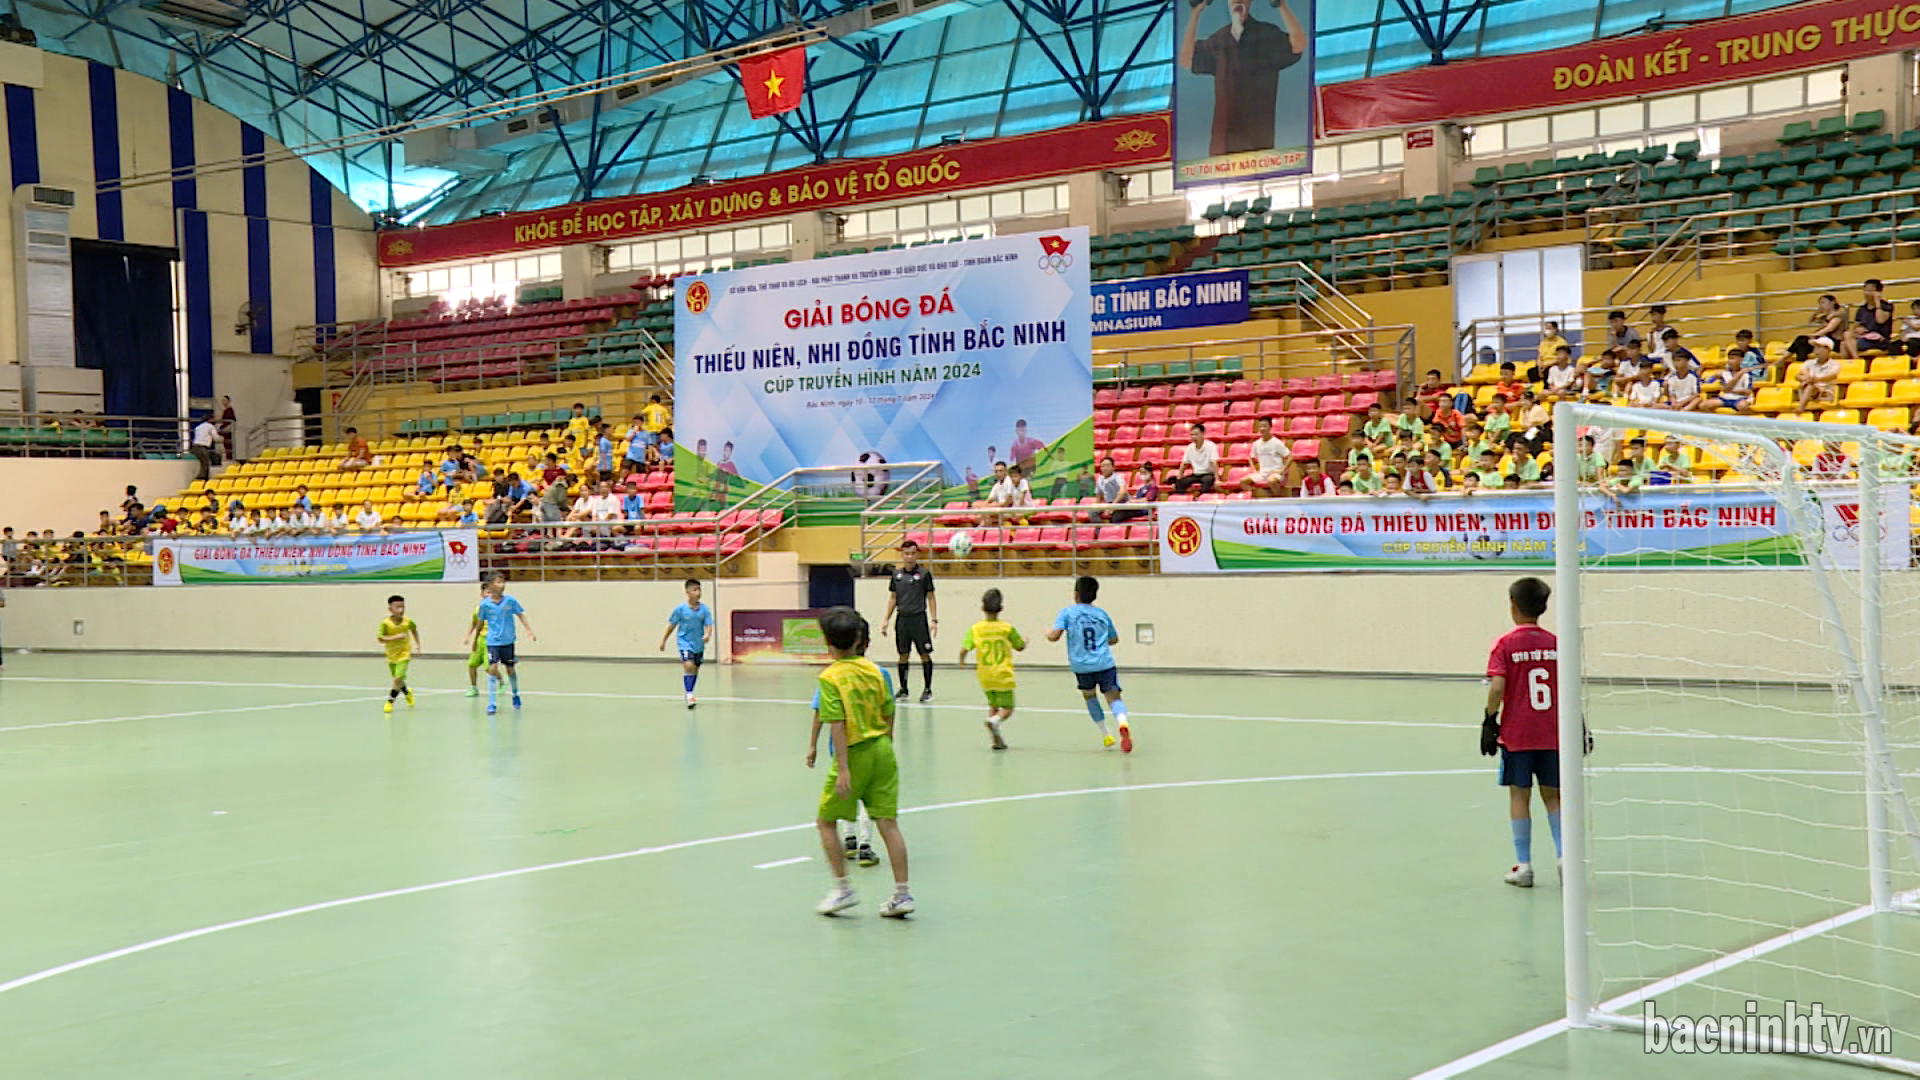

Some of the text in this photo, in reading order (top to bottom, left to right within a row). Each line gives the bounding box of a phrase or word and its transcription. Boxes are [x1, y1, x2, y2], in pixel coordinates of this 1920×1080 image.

[1553, 53, 1636, 91] ĐOÀN
[1643, 37, 1692, 79] KẾT
[1717, 25, 1822, 66] TRUNG
[1832, 3, 1920, 45] THỰC
[514, 154, 961, 243] KHỎE ĐỂ HỌC TẬP, XÂY DỰNG & BẢO VỆ TỔ QUỐC
[784, 286, 955, 329] GIẢI BÓNG ĐÁ
[1090, 279, 1242, 315] G TỈNH BẮC NINH
[694, 319, 1066, 374] THIẾU NIÊN, NHI ĐỒNG TỈNH BẮC NINH
[764, 363, 981, 394] CÚP TRUYỀN HÌNH NĂM 2024
[1243, 512, 1279, 535] GIẢI
[1284, 512, 1335, 535] BÓNG
[1340, 511, 1365, 533] ĐÁ
[1371, 508, 1428, 532] THIẾU
[1495, 512, 1529, 531] NHI
[1536, 511, 1596, 530] ĐG
[1663, 501, 1708, 528] BẮC
[1717, 505, 1776, 528] NINH
[981, 639, 1006, 666] 20
[1083, 627, 1096, 651] 8
[1528, 667, 1552, 711] 6
